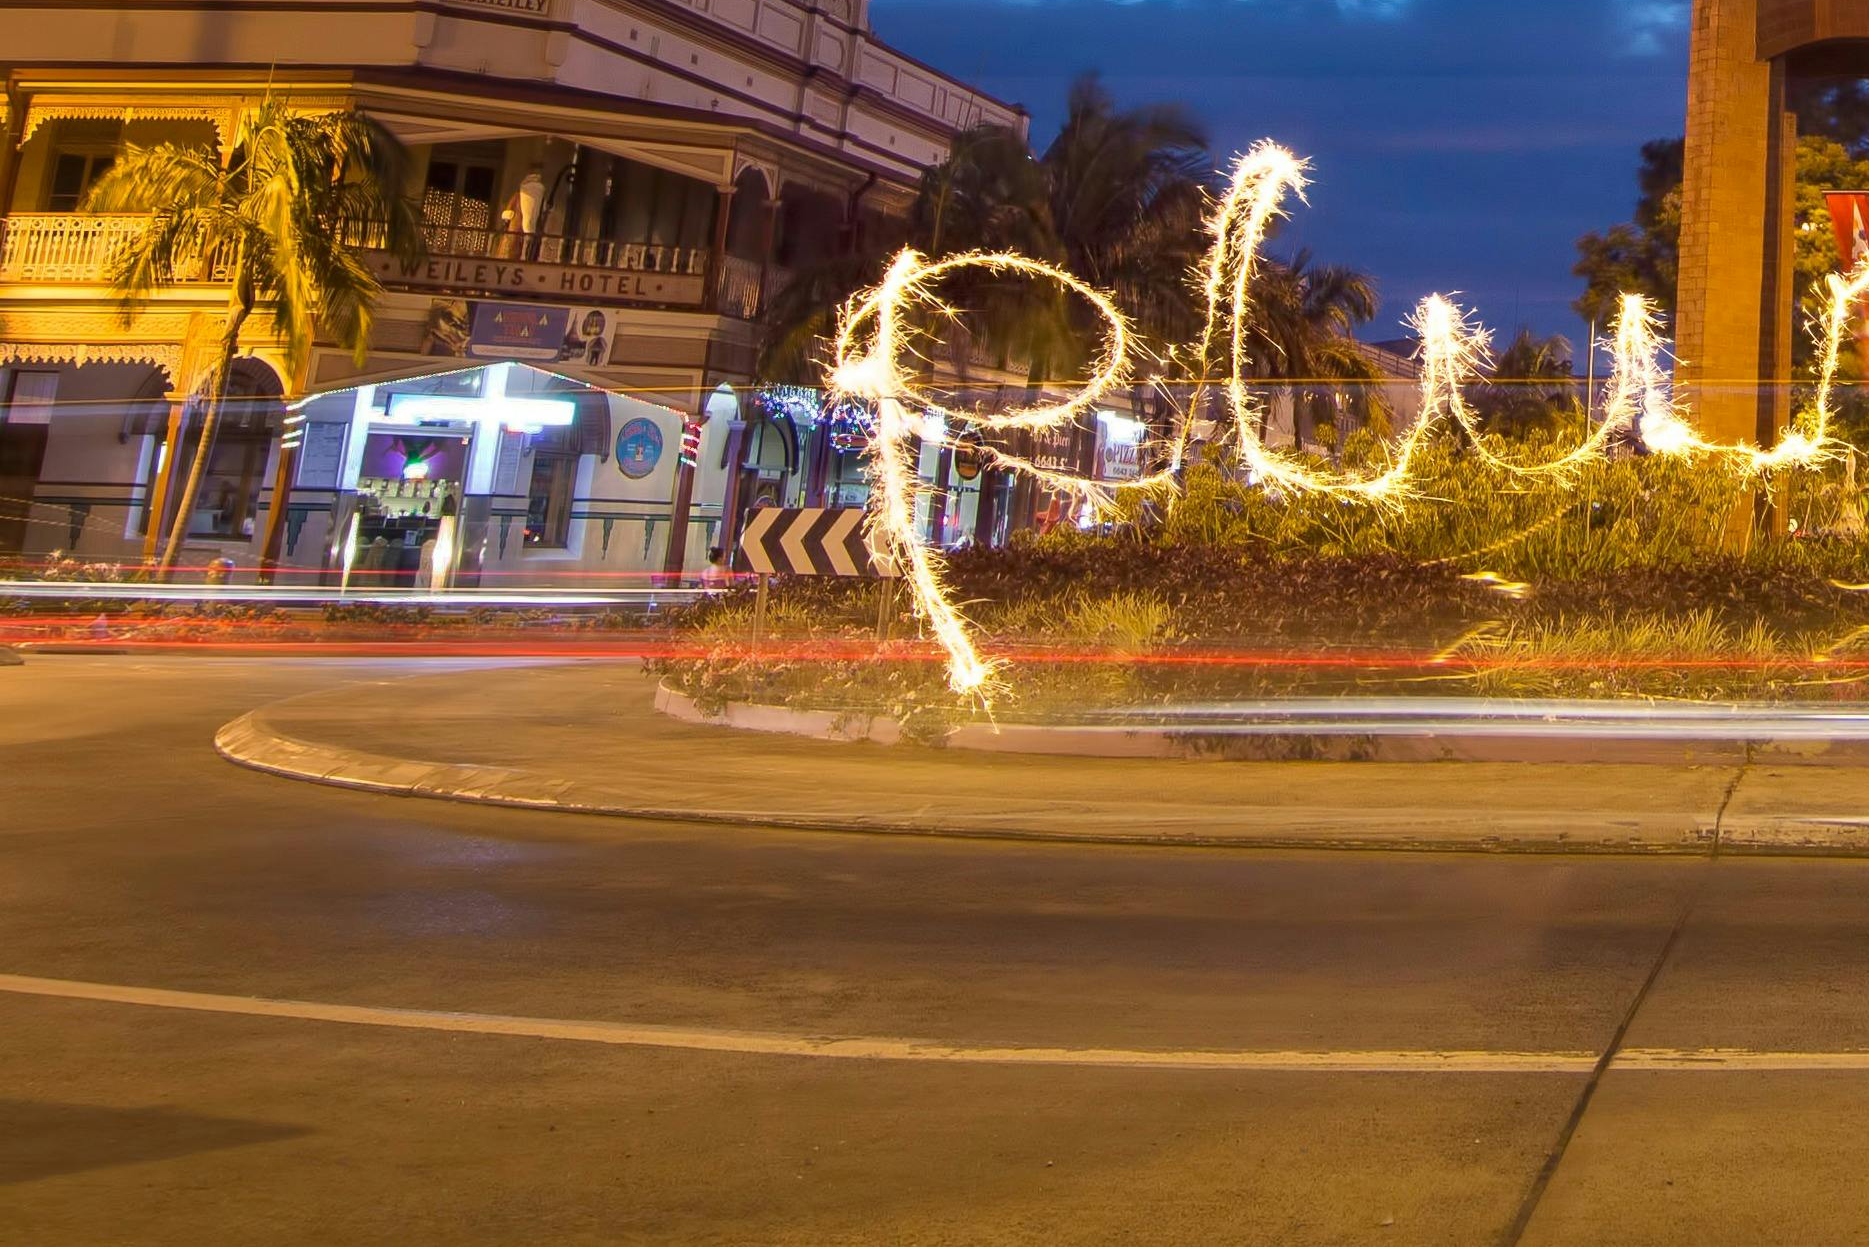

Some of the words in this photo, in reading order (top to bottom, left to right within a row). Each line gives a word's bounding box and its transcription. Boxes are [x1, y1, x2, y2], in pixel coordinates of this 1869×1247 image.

[400, 260, 525, 287] WEILEYS
[560, 270, 646, 296] HOTEL
[1112, 442, 1141, 466] PIZZ
